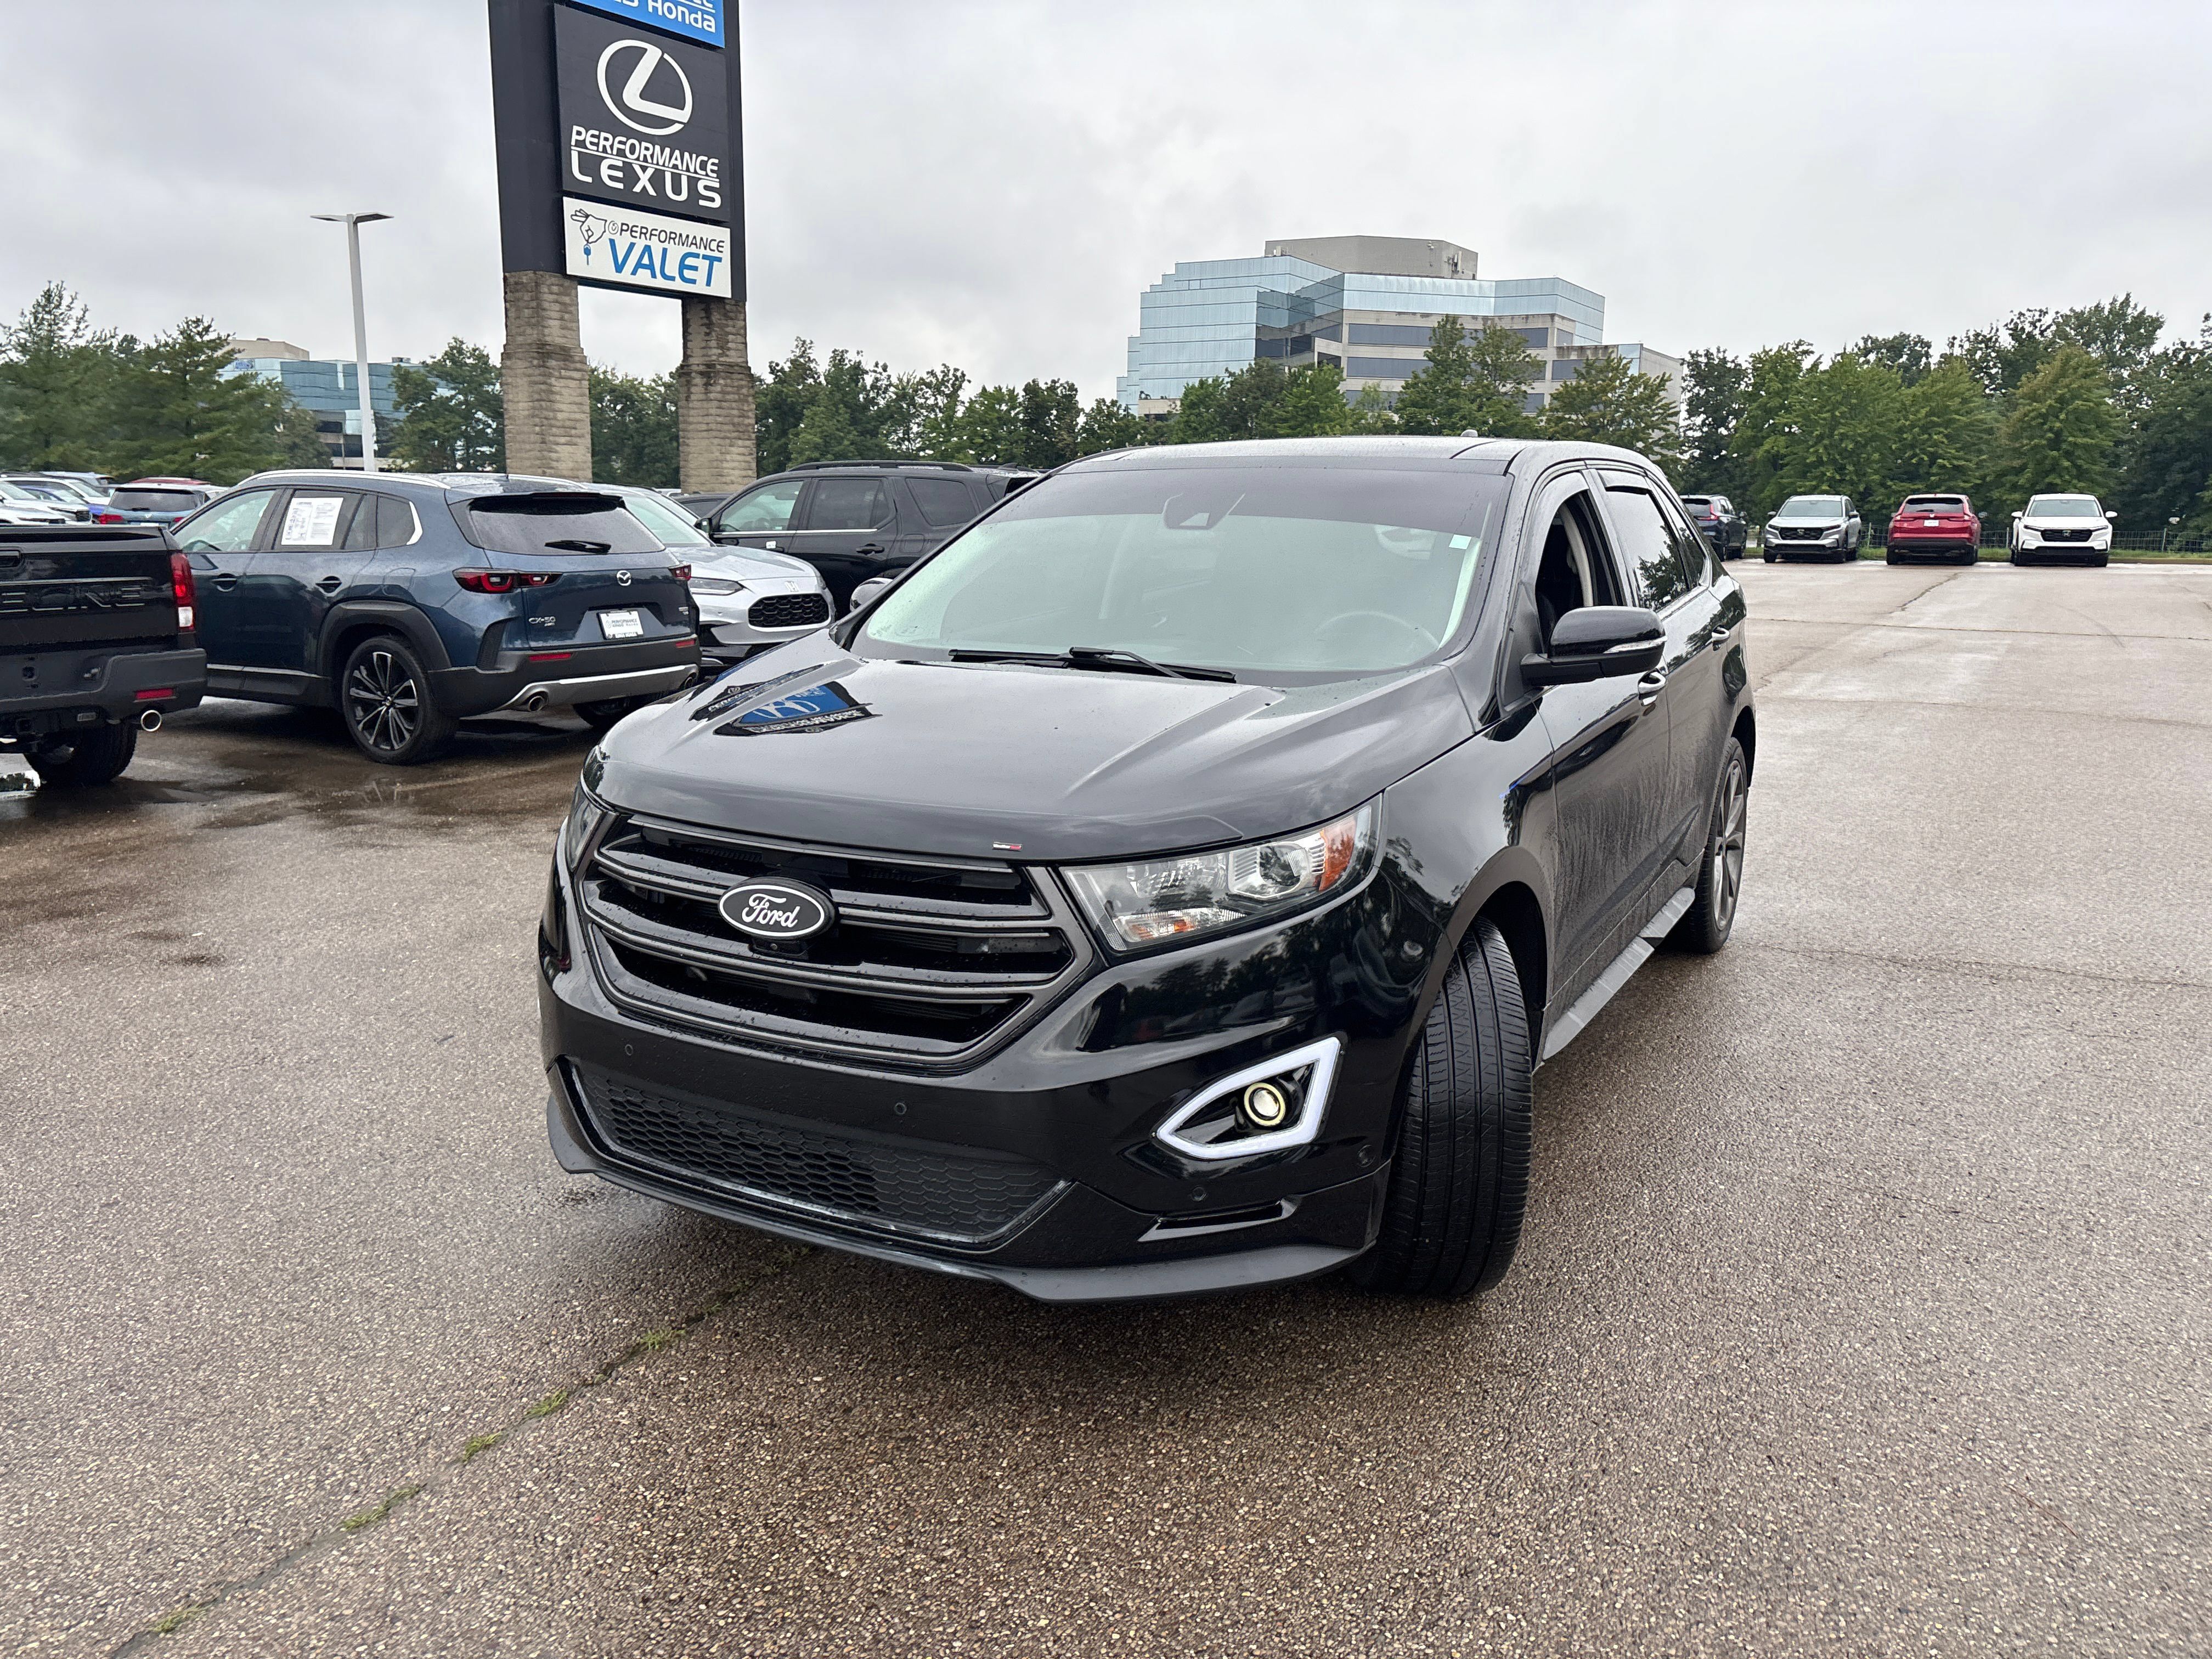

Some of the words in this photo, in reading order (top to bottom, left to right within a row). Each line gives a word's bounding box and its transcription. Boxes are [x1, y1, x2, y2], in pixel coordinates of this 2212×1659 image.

[648, 0, 716, 33] Honda
[571, 125, 719, 177] PERFORMANCE
[571, 150, 721, 208] LEXUS
[619, 222, 725, 253] PERFORMANCE
[608, 238, 723, 287] VALET
[742, 893, 800, 928] Ford
